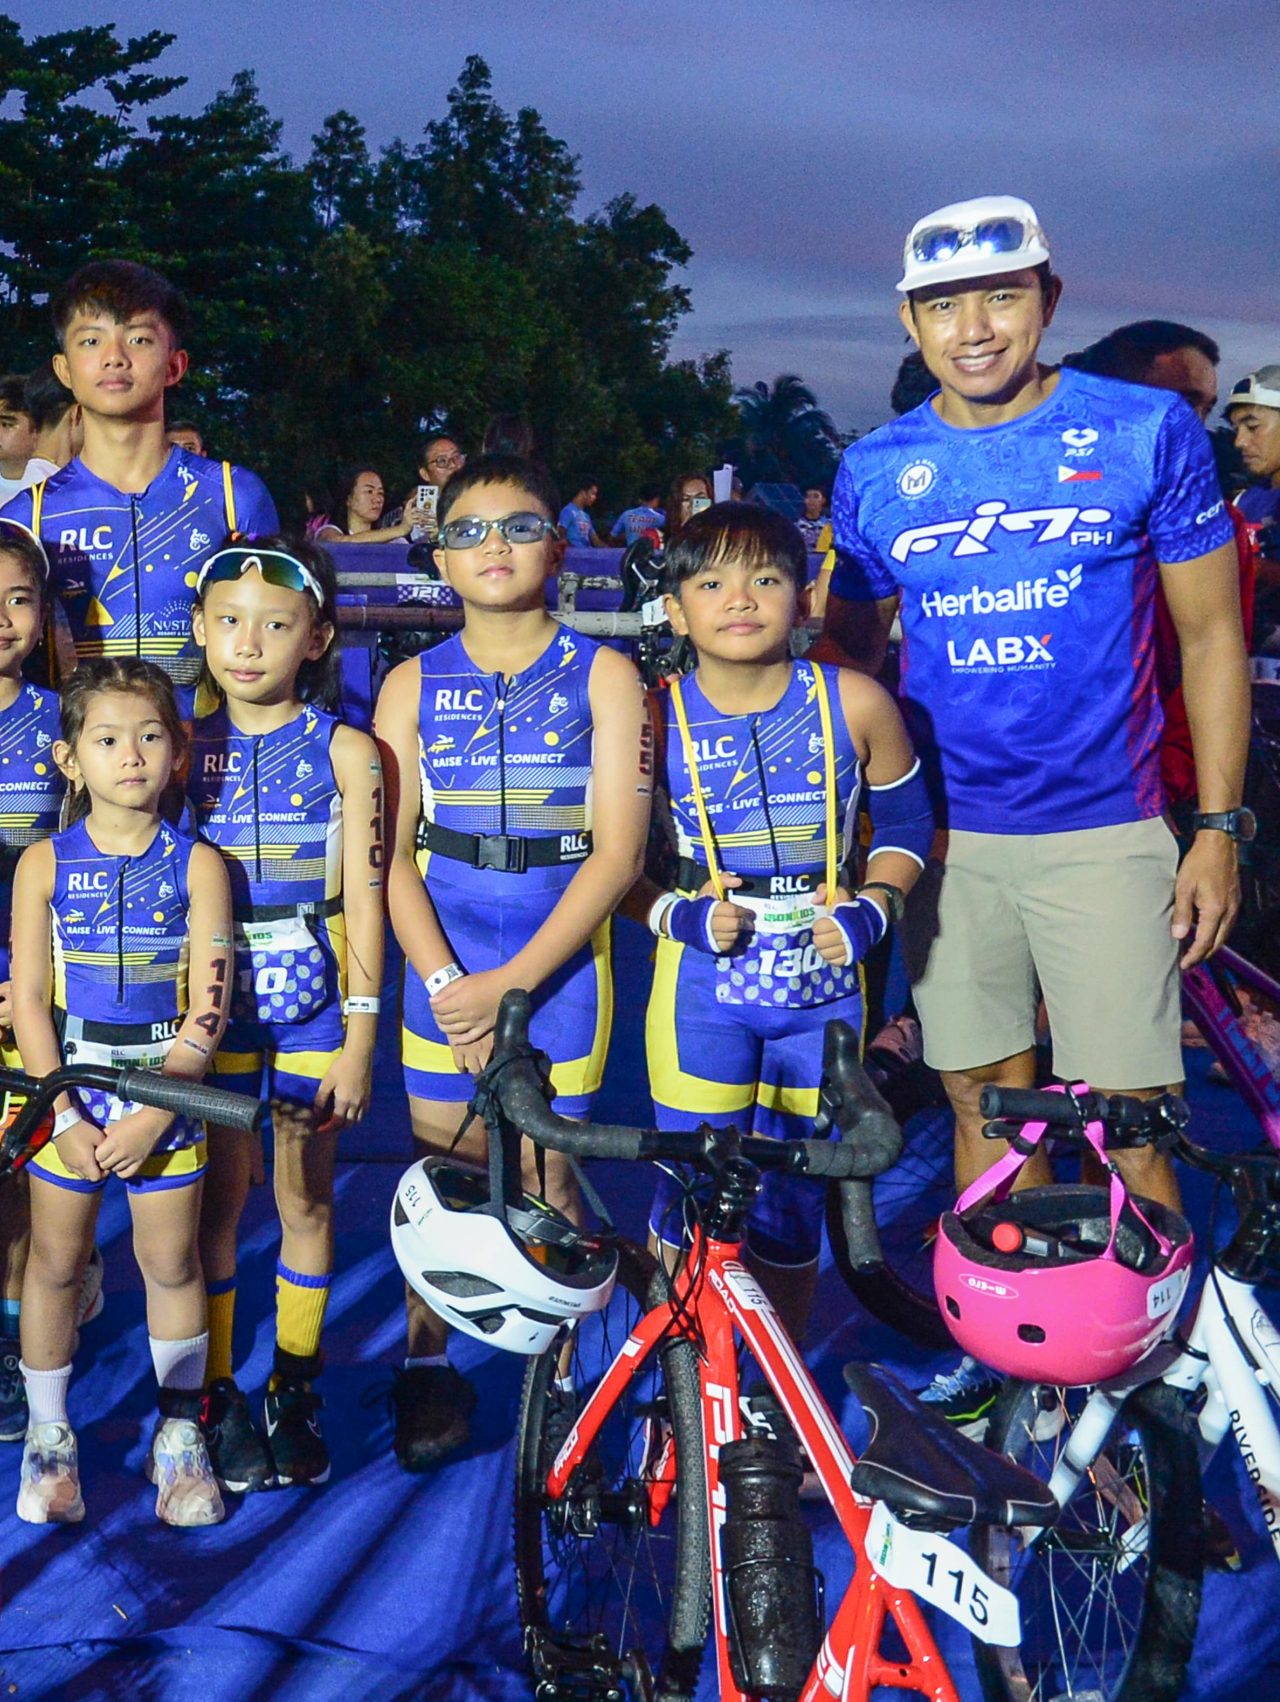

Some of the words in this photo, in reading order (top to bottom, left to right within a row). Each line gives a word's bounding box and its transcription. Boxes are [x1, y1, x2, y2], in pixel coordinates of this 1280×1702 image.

[59, 525, 113, 553] RLC
[1070, 531, 1113, 546] PH
[58, 554, 114, 565] RESIDENCES
[412, 586, 440, 598] 121
[921, 577, 1070, 618] Herbalife
[947, 633, 1054, 667] LABX
[951, 664, 1005, 675] EMPOWERING
[1007, 662, 1057, 673] HUMANITY
[434, 689, 483, 712] RLC
[434, 713, 483, 722] RESIDENCES
[203, 751, 242, 773] RLC
[432, 756, 462, 768] RAISE
[470, 754, 498, 766] LIVE
[503, 753, 566, 765] CONNECT
[732, 797, 761, 811] LIVE
[766, 790, 828, 805] CONNECT
[231, 813, 253, 824] LIVE
[258, 811, 308, 823] CONNECT
[560, 831, 590, 853] RLC
[67, 871, 108, 892] RLC
[770, 874, 811, 894] RLC
[67, 891, 109, 900] RESIDENCES
[66, 924, 92, 935] RAISE
[96, 925, 117, 935] LIVE
[121, 925, 168, 936] CONNECT
[758, 944, 823, 978] 130
[193, 957, 226, 1039] 114
[1228, 1409, 1280, 1542] RIVERSIDE
[921, 1552, 989, 1626] 115
